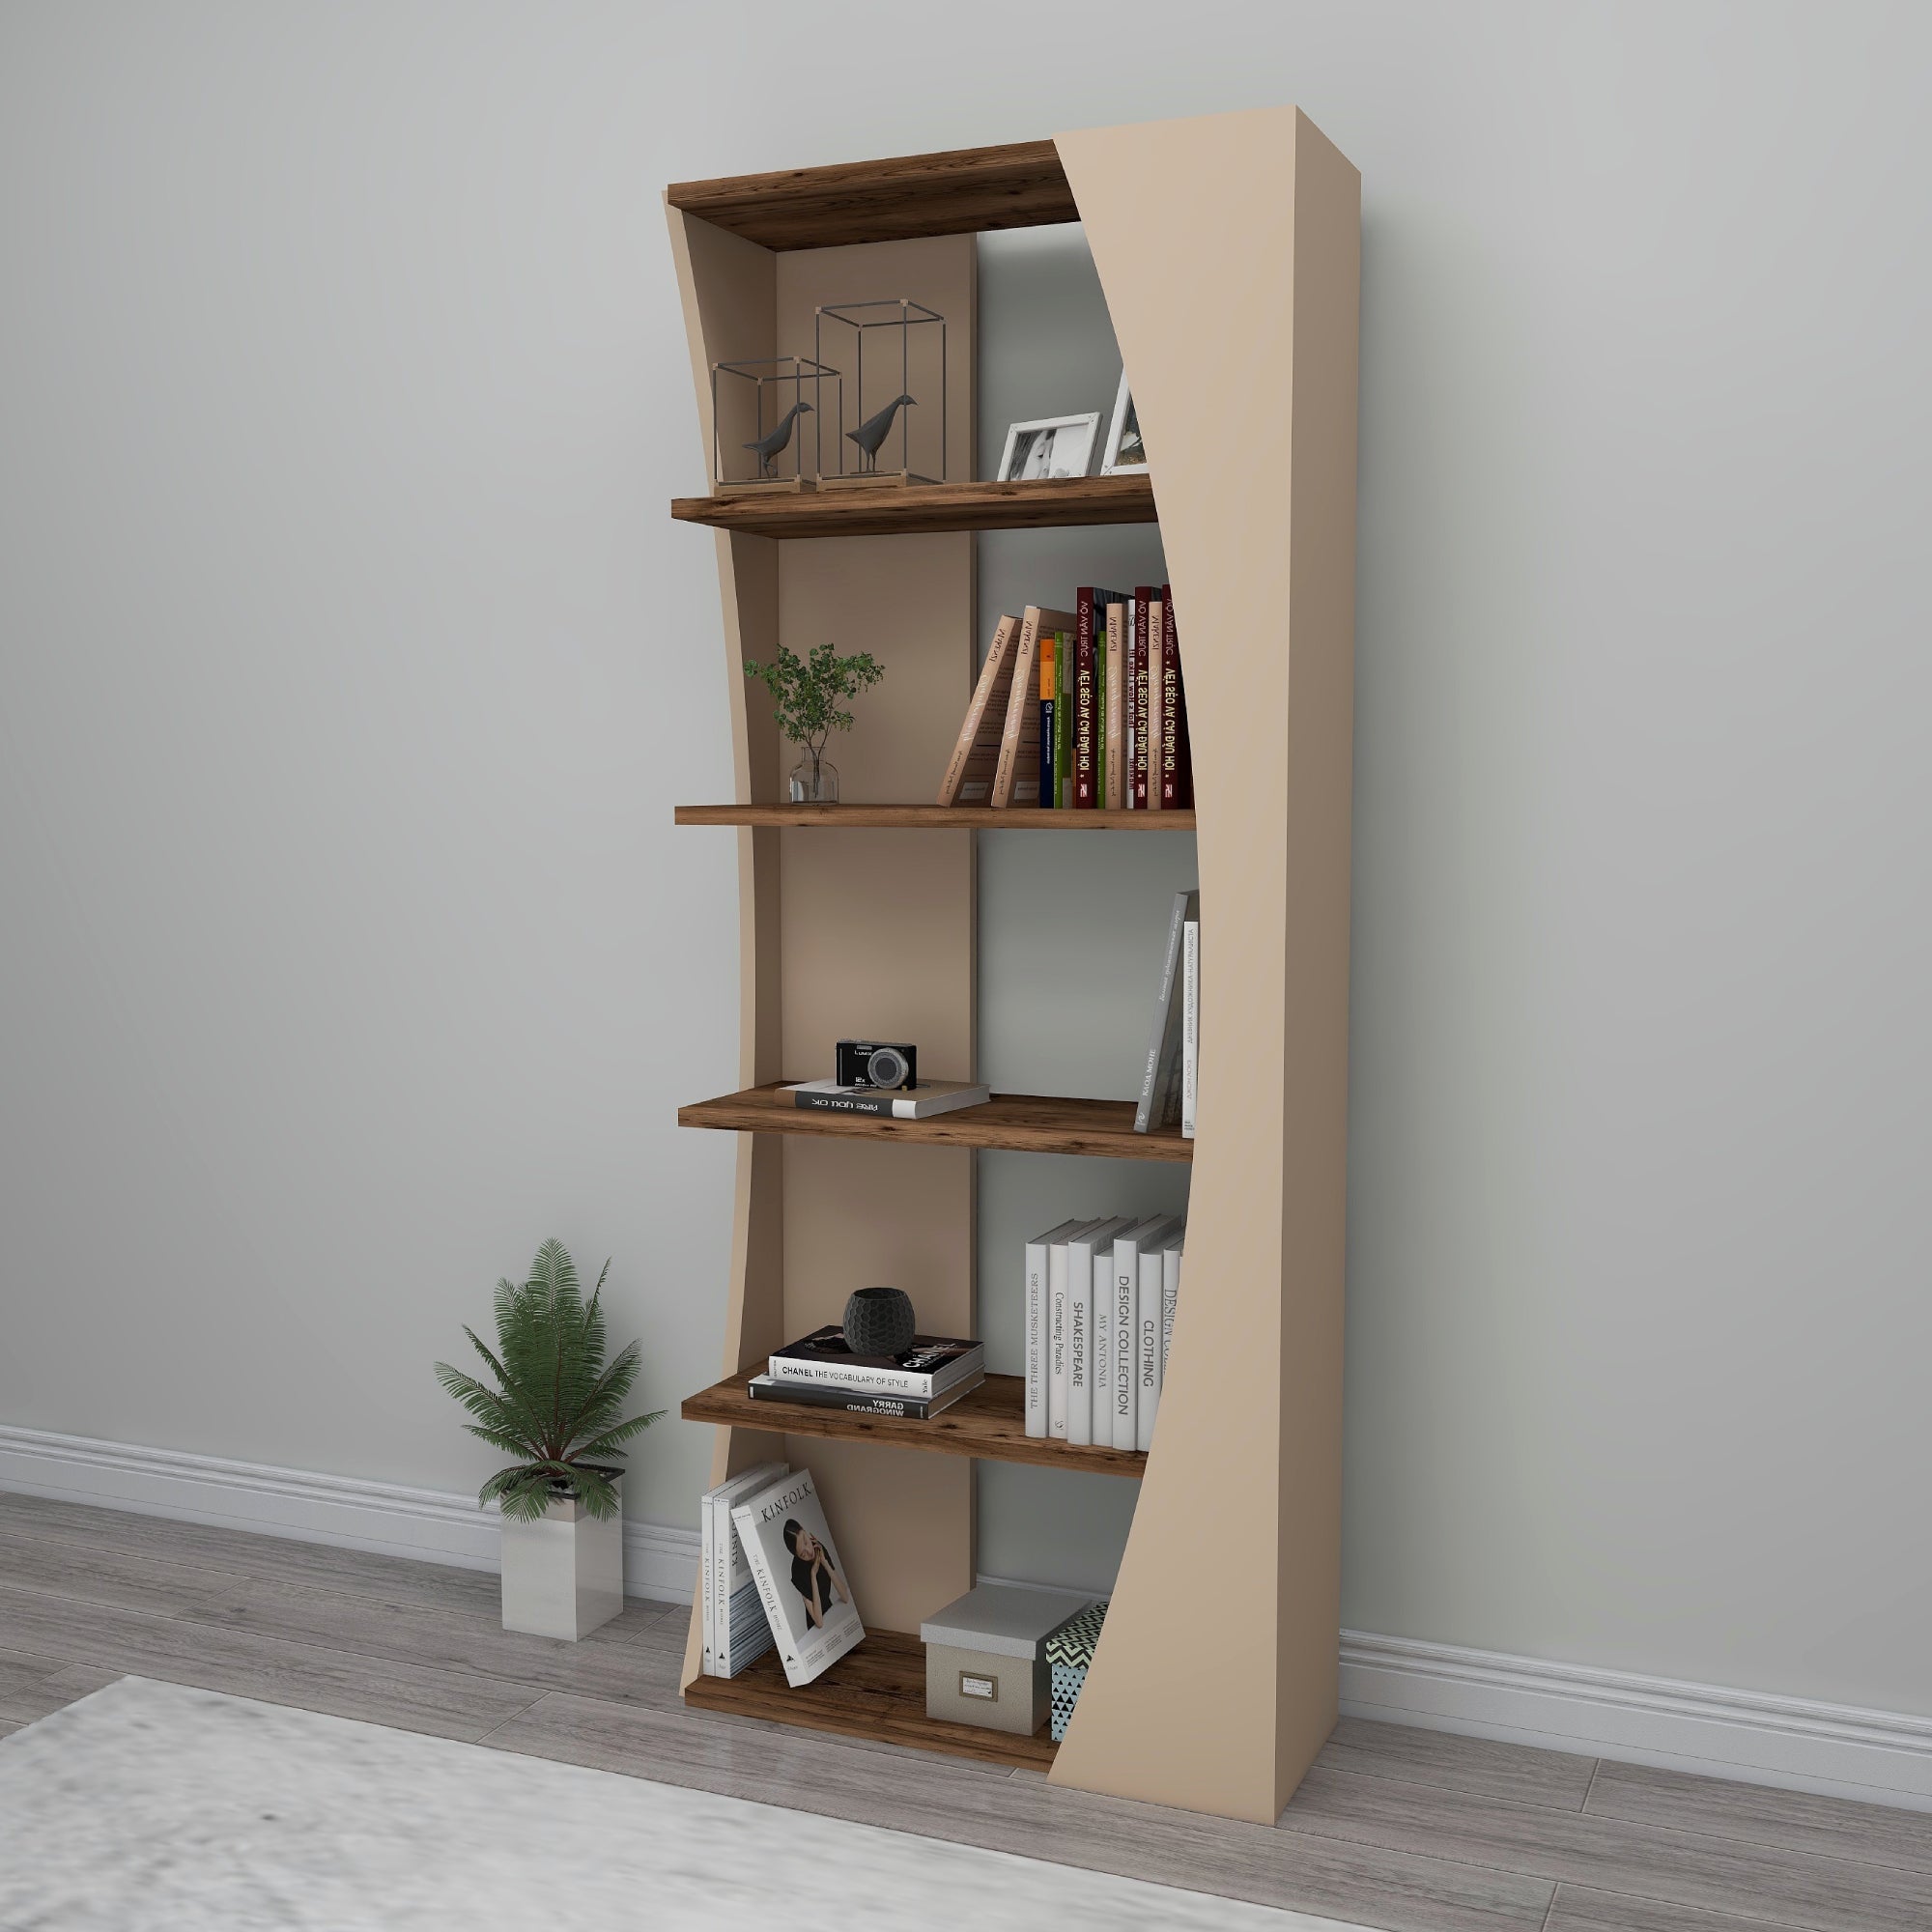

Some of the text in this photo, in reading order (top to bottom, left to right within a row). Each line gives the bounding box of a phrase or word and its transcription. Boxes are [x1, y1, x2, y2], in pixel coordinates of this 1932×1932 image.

[1143, 1049, 1156, 1096] КЛОД МОНЕ
[1053, 1292, 1064, 1341] Constructing
[1099, 1314, 1107, 1331] MY
[1073, 1302, 1084, 1387] SHAKESPEARE
[1118, 1276, 1129, 1415] DESIGN COLLECTION
[1143, 1320, 1154, 1387] CLOTHING
[782, 1366, 813, 1378] CHANEL
[815, 1370, 828, 1378] THE
[828, 1371, 875, 1384] VOCABULARY
[876, 1377, 885, 1385] OF
[887, 1378, 909, 1388] STYLE
[761, 1482, 812, 1523] KINFOLK
[757, 1568, 777, 1612] KINFOLK
